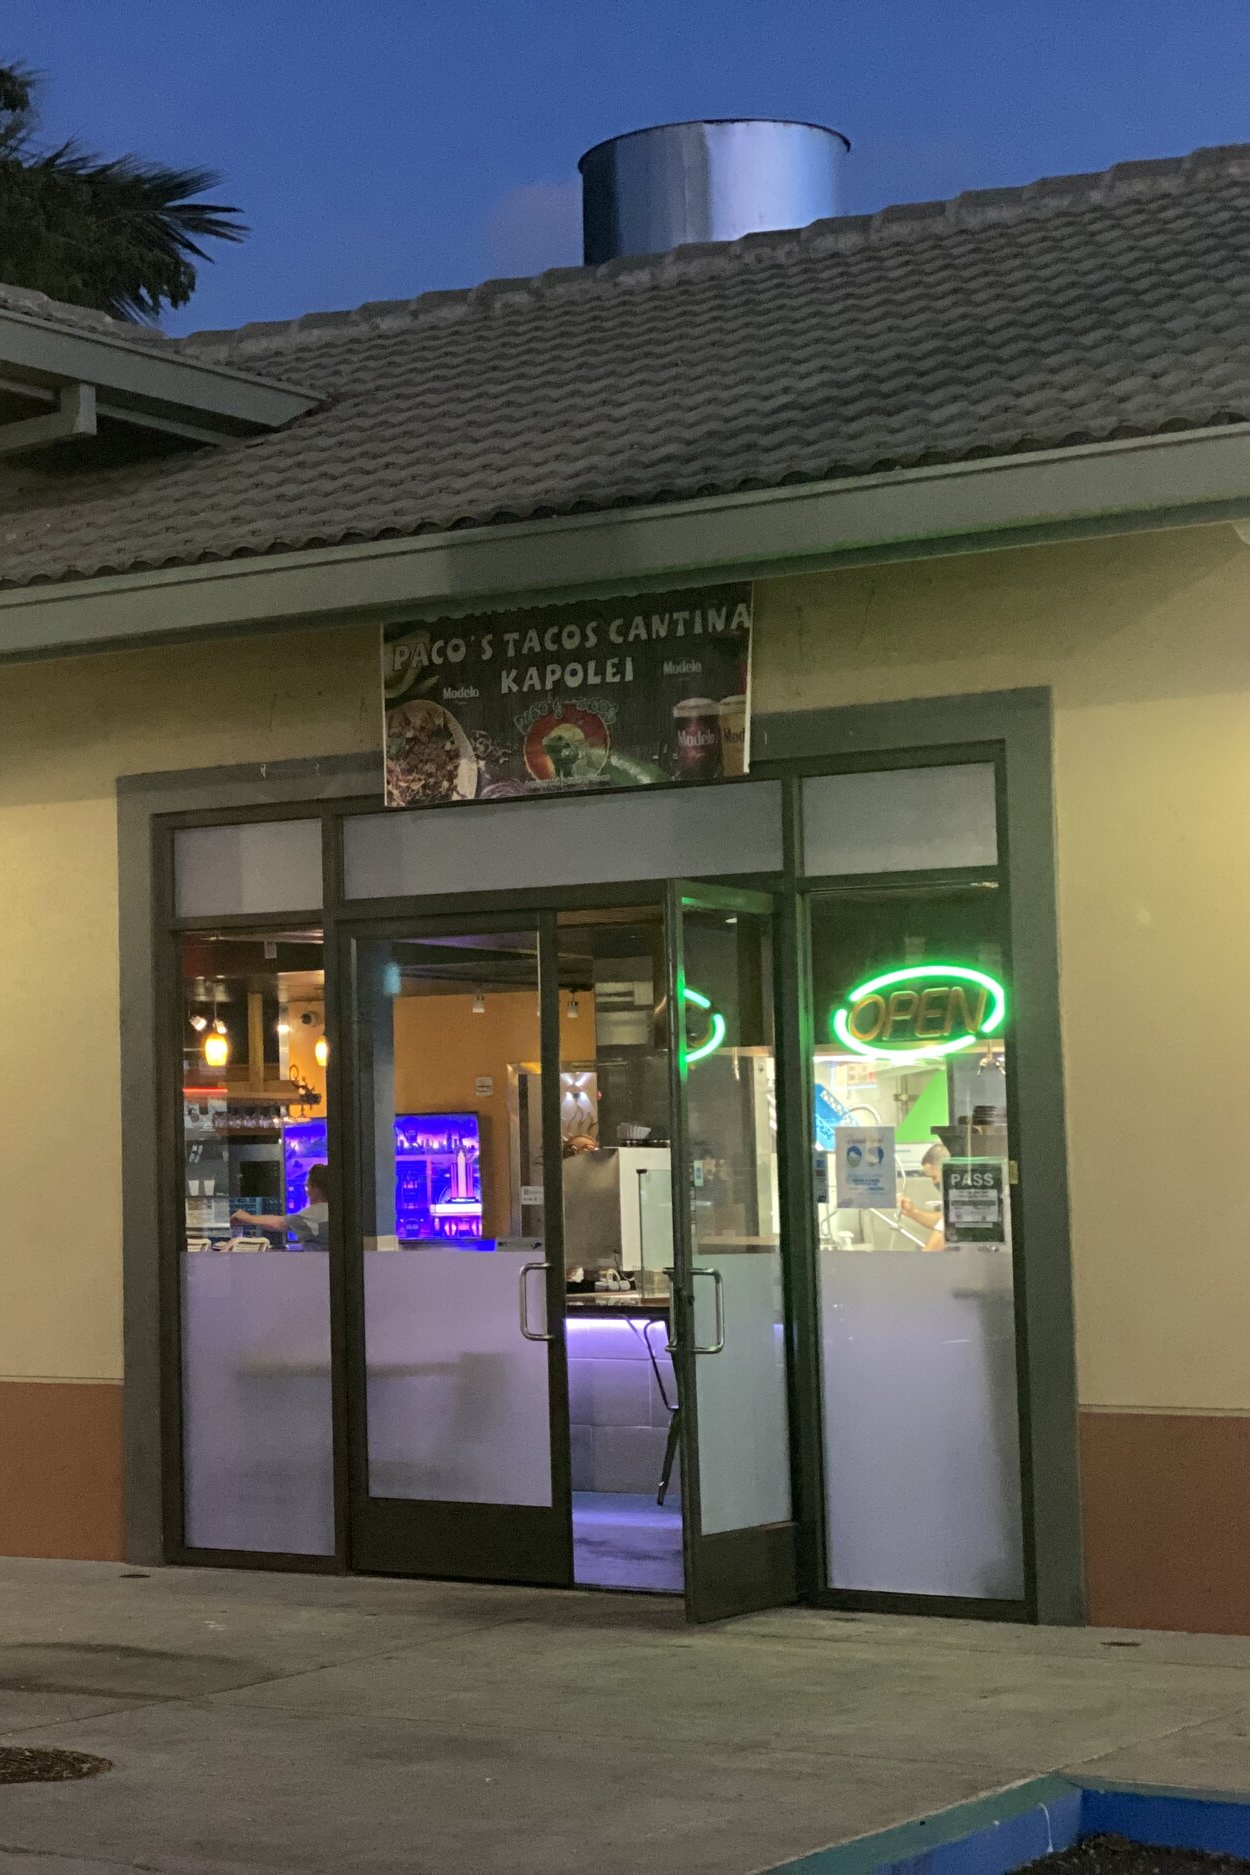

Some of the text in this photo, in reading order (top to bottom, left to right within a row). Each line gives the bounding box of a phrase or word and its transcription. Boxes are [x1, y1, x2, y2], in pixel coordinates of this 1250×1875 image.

[394, 603, 751, 671] PACO'S TACOS CANTINA
[501, 656, 634, 694] KAPOLEI
[663, 659, 702, 675] Modelo
[443, 685, 479, 699] Modelo
[678, 727, 716, 746] Modelo
[848, 986, 987, 1041] OPEN
[950, 1173, 994, 1186] PASS
